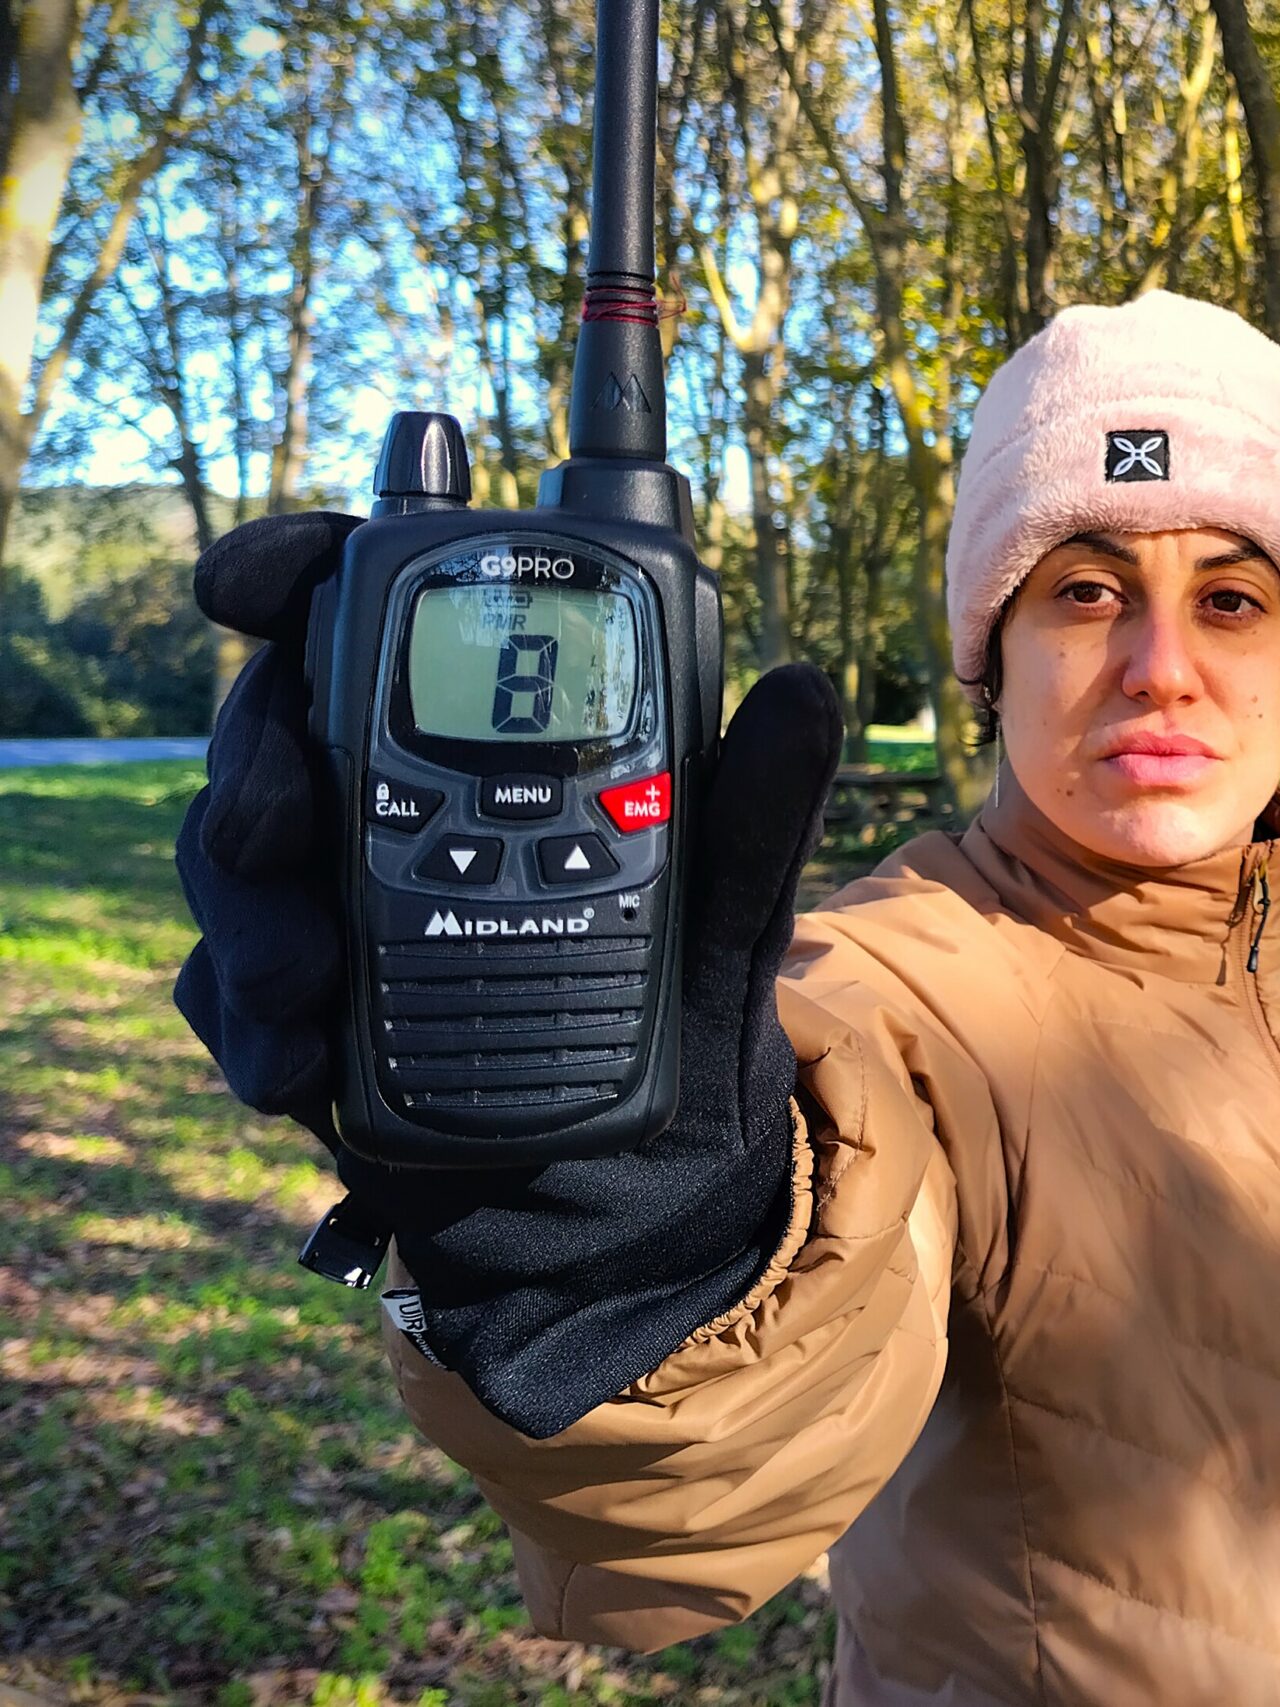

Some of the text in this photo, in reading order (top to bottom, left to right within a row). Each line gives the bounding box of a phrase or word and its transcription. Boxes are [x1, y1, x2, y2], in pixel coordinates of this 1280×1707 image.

[481, 555, 575, 579] G9PRO
[483, 614, 526, 630] PMR
[492, 634, 559, 734] 8
[495, 787, 552, 803] MENU
[375, 801, 420, 817] CALL
[624, 802, 661, 817] EMG
[619, 895, 640, 907] MIC
